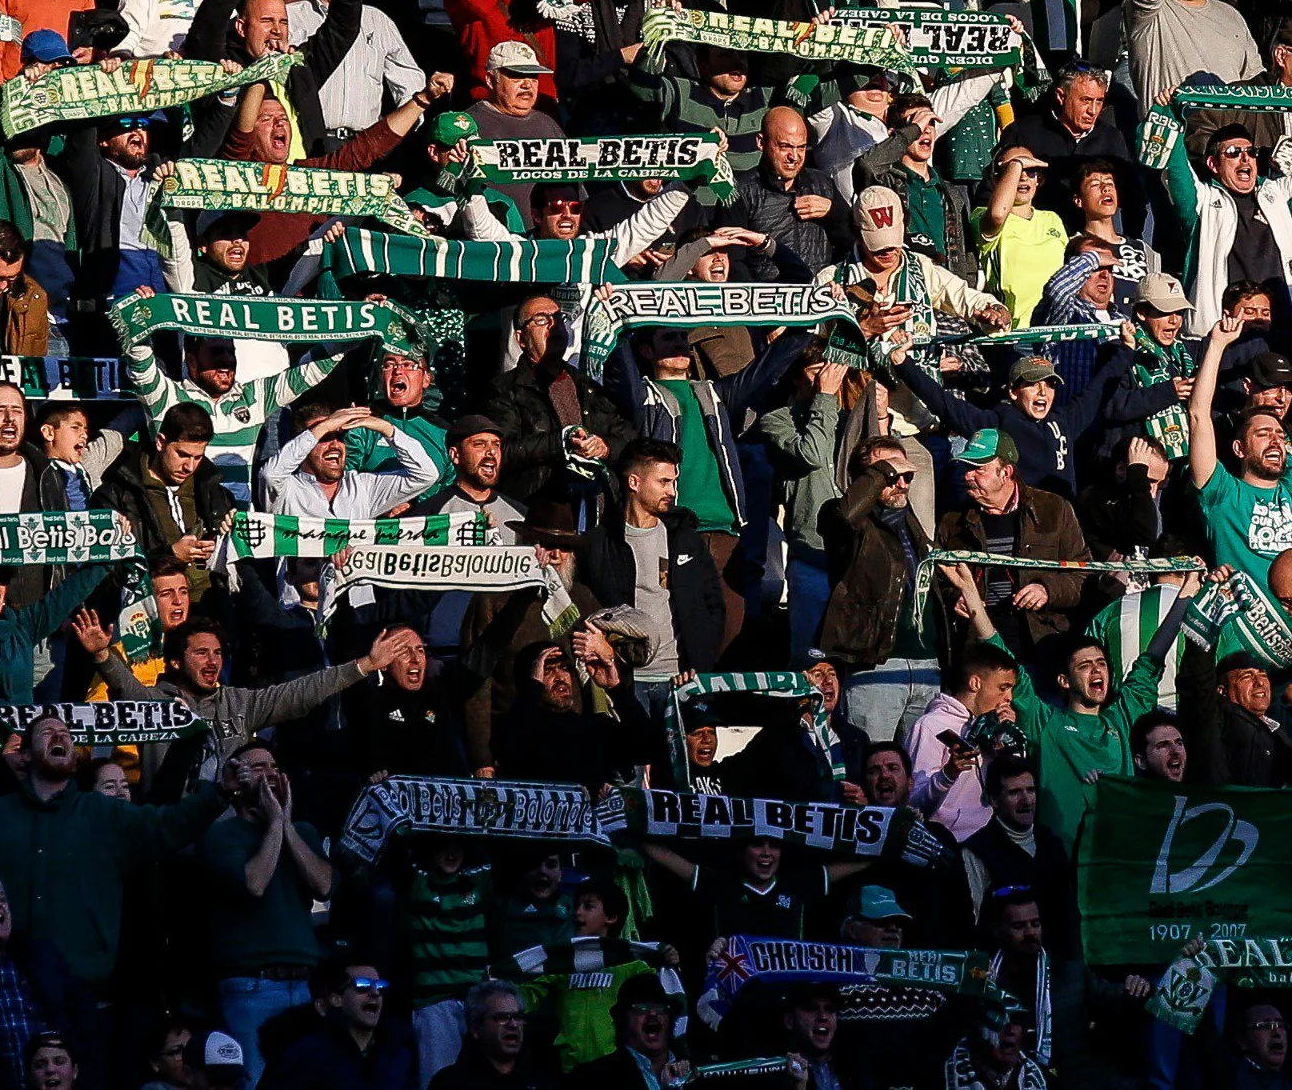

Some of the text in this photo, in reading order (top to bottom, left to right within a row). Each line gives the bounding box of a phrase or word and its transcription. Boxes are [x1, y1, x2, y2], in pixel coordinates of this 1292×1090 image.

[897, 11, 915, 21] LA
[921, 12, 941, 21] DE
[947, 12, 998, 22] LOCOS
[816, 22, 893, 47] BETI
[758, 36, 862, 60] BALOMPIE
[910, 55, 994, 64] DICEN QUE
[61, 63, 227, 101] REAL BETI
[493, 137, 703, 170] REAL BETIS
[176, 160, 392, 197] REAL BETIS
[512, 169, 680, 180] LOCOS DE LA CABEZA
[232, 193, 341, 211] BALOMPIE
[172, 299, 377, 331] REAL BETIS
[606, 285, 838, 323] REAL BETIS
[3, 355, 121, 399] EAL BETI
[16, 527, 77, 550] Betis
[282, 521, 441, 551] manque pierda
[91, 701, 195, 731] BETIS
[94, 733, 114, 743] LA
[118, 731, 180, 742] CABEZA
[650, 791, 887, 847] REAL BETIS
[1149, 922, 1247, 939] 1907 2007
[750, 941, 855, 973] CHELSEA
[893, 959, 958, 984] BETIS
